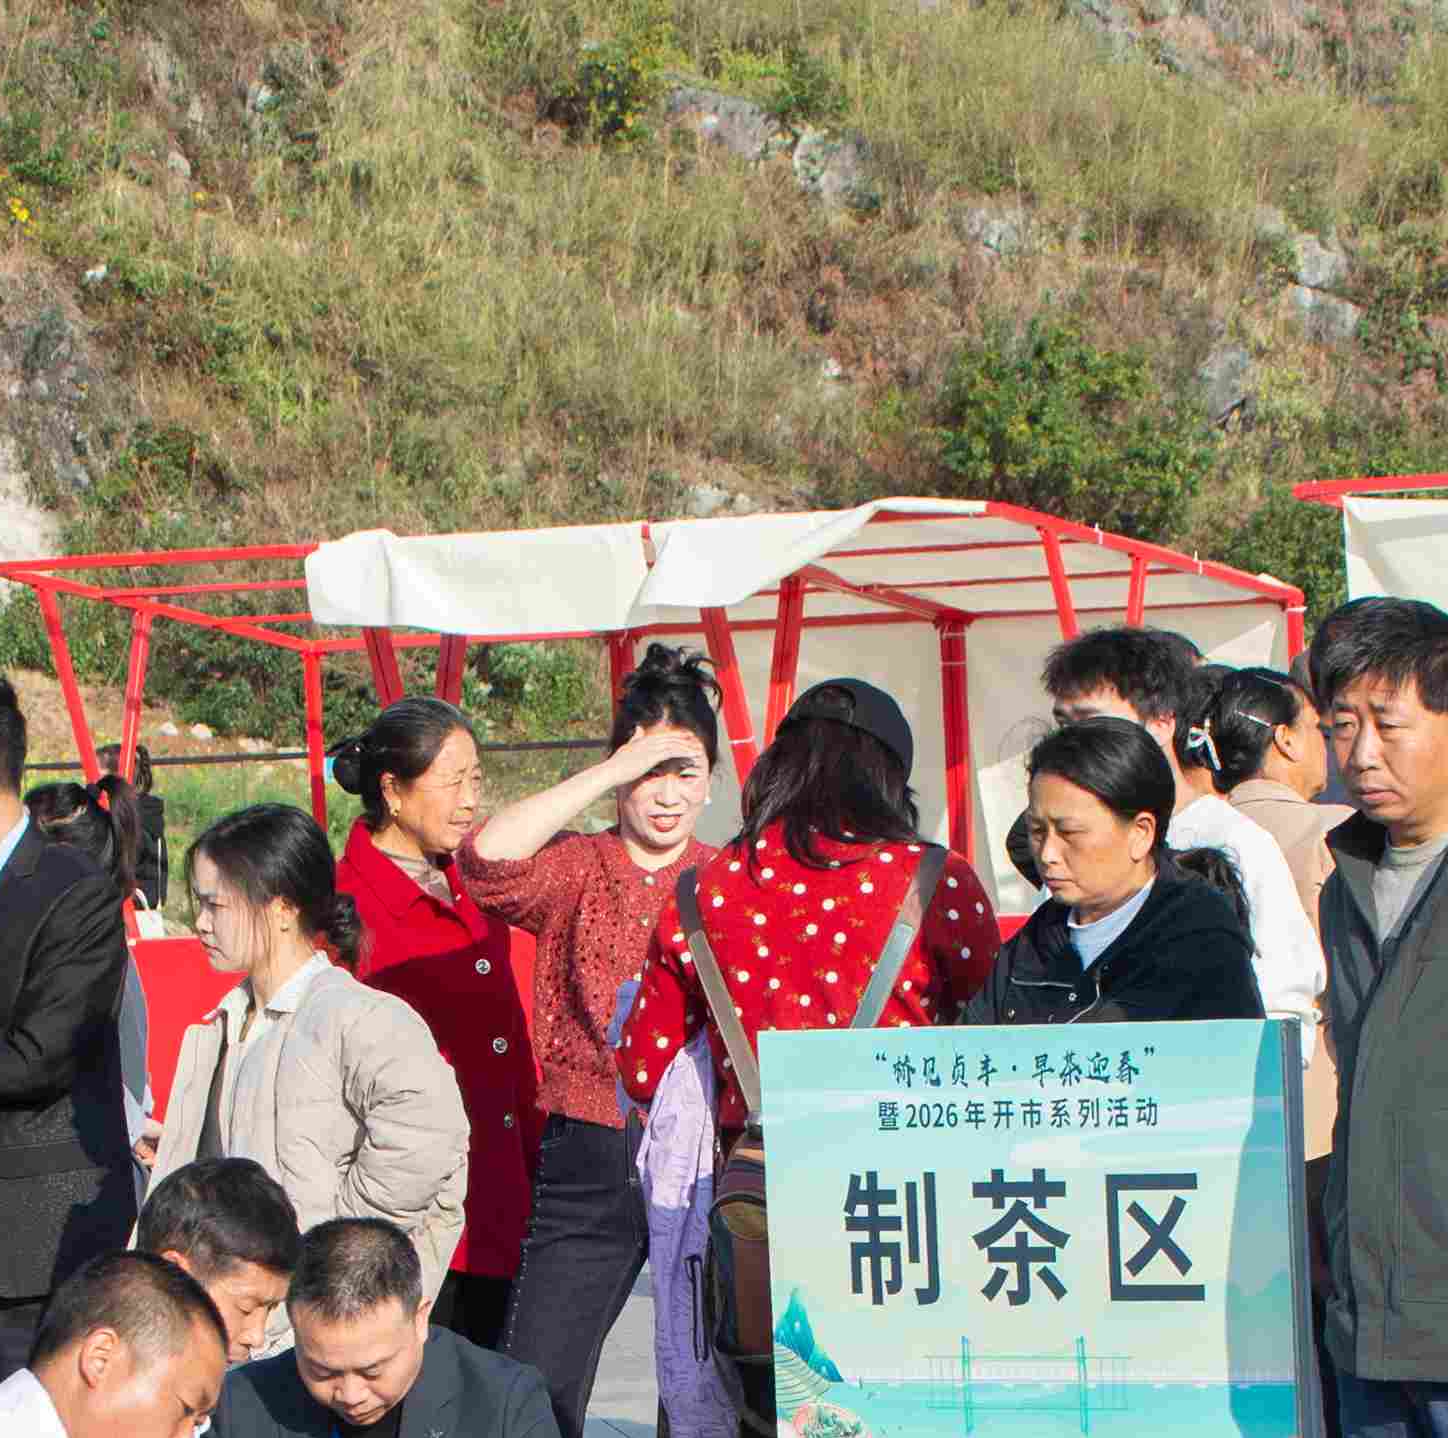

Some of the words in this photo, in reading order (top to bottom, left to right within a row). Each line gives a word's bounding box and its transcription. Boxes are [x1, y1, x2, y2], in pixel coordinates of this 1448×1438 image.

[877, 1095, 1159, 1132] 暨2026年开市系列活动
[842, 1167, 1206, 1307] 制茶区
